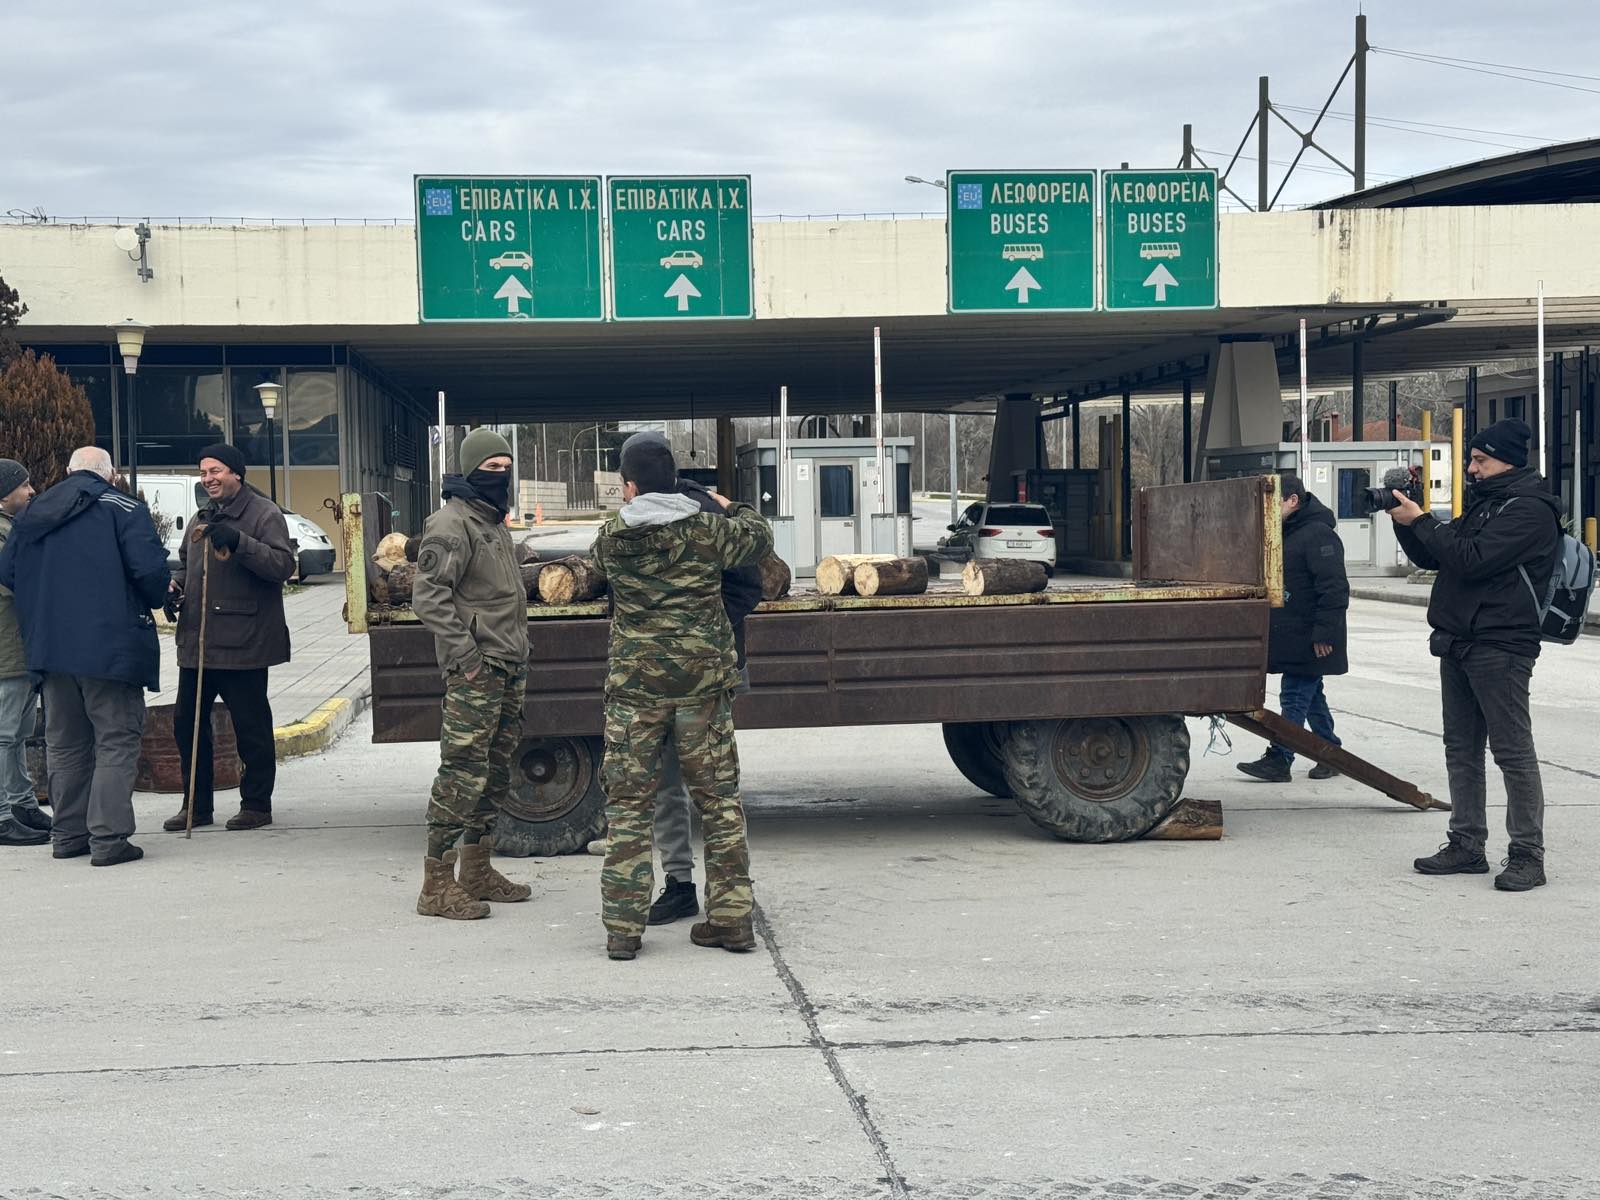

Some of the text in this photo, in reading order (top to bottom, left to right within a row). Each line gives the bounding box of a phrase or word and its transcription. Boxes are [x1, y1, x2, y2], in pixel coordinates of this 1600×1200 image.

[432, 197, 447, 207] EU
[460, 188, 560, 210] ΕΠΙΒΑΤΙΚΑ
[616, 188, 712, 210] ΕΠΙΒΑΤΙΚΑ
[963, 192, 977, 201] EU
[990, 182, 1090, 204] ΛΕΩΦΟΡΕΙΑ
[1110, 181, 1210, 204] ΛΕΩΦΟΡΕΙΑ
[461, 220, 516, 242] CARS
[656, 219, 706, 241] CARS
[990, 213, 1049, 235] BUSES
[1128, 212, 1186, 234] BUSES
